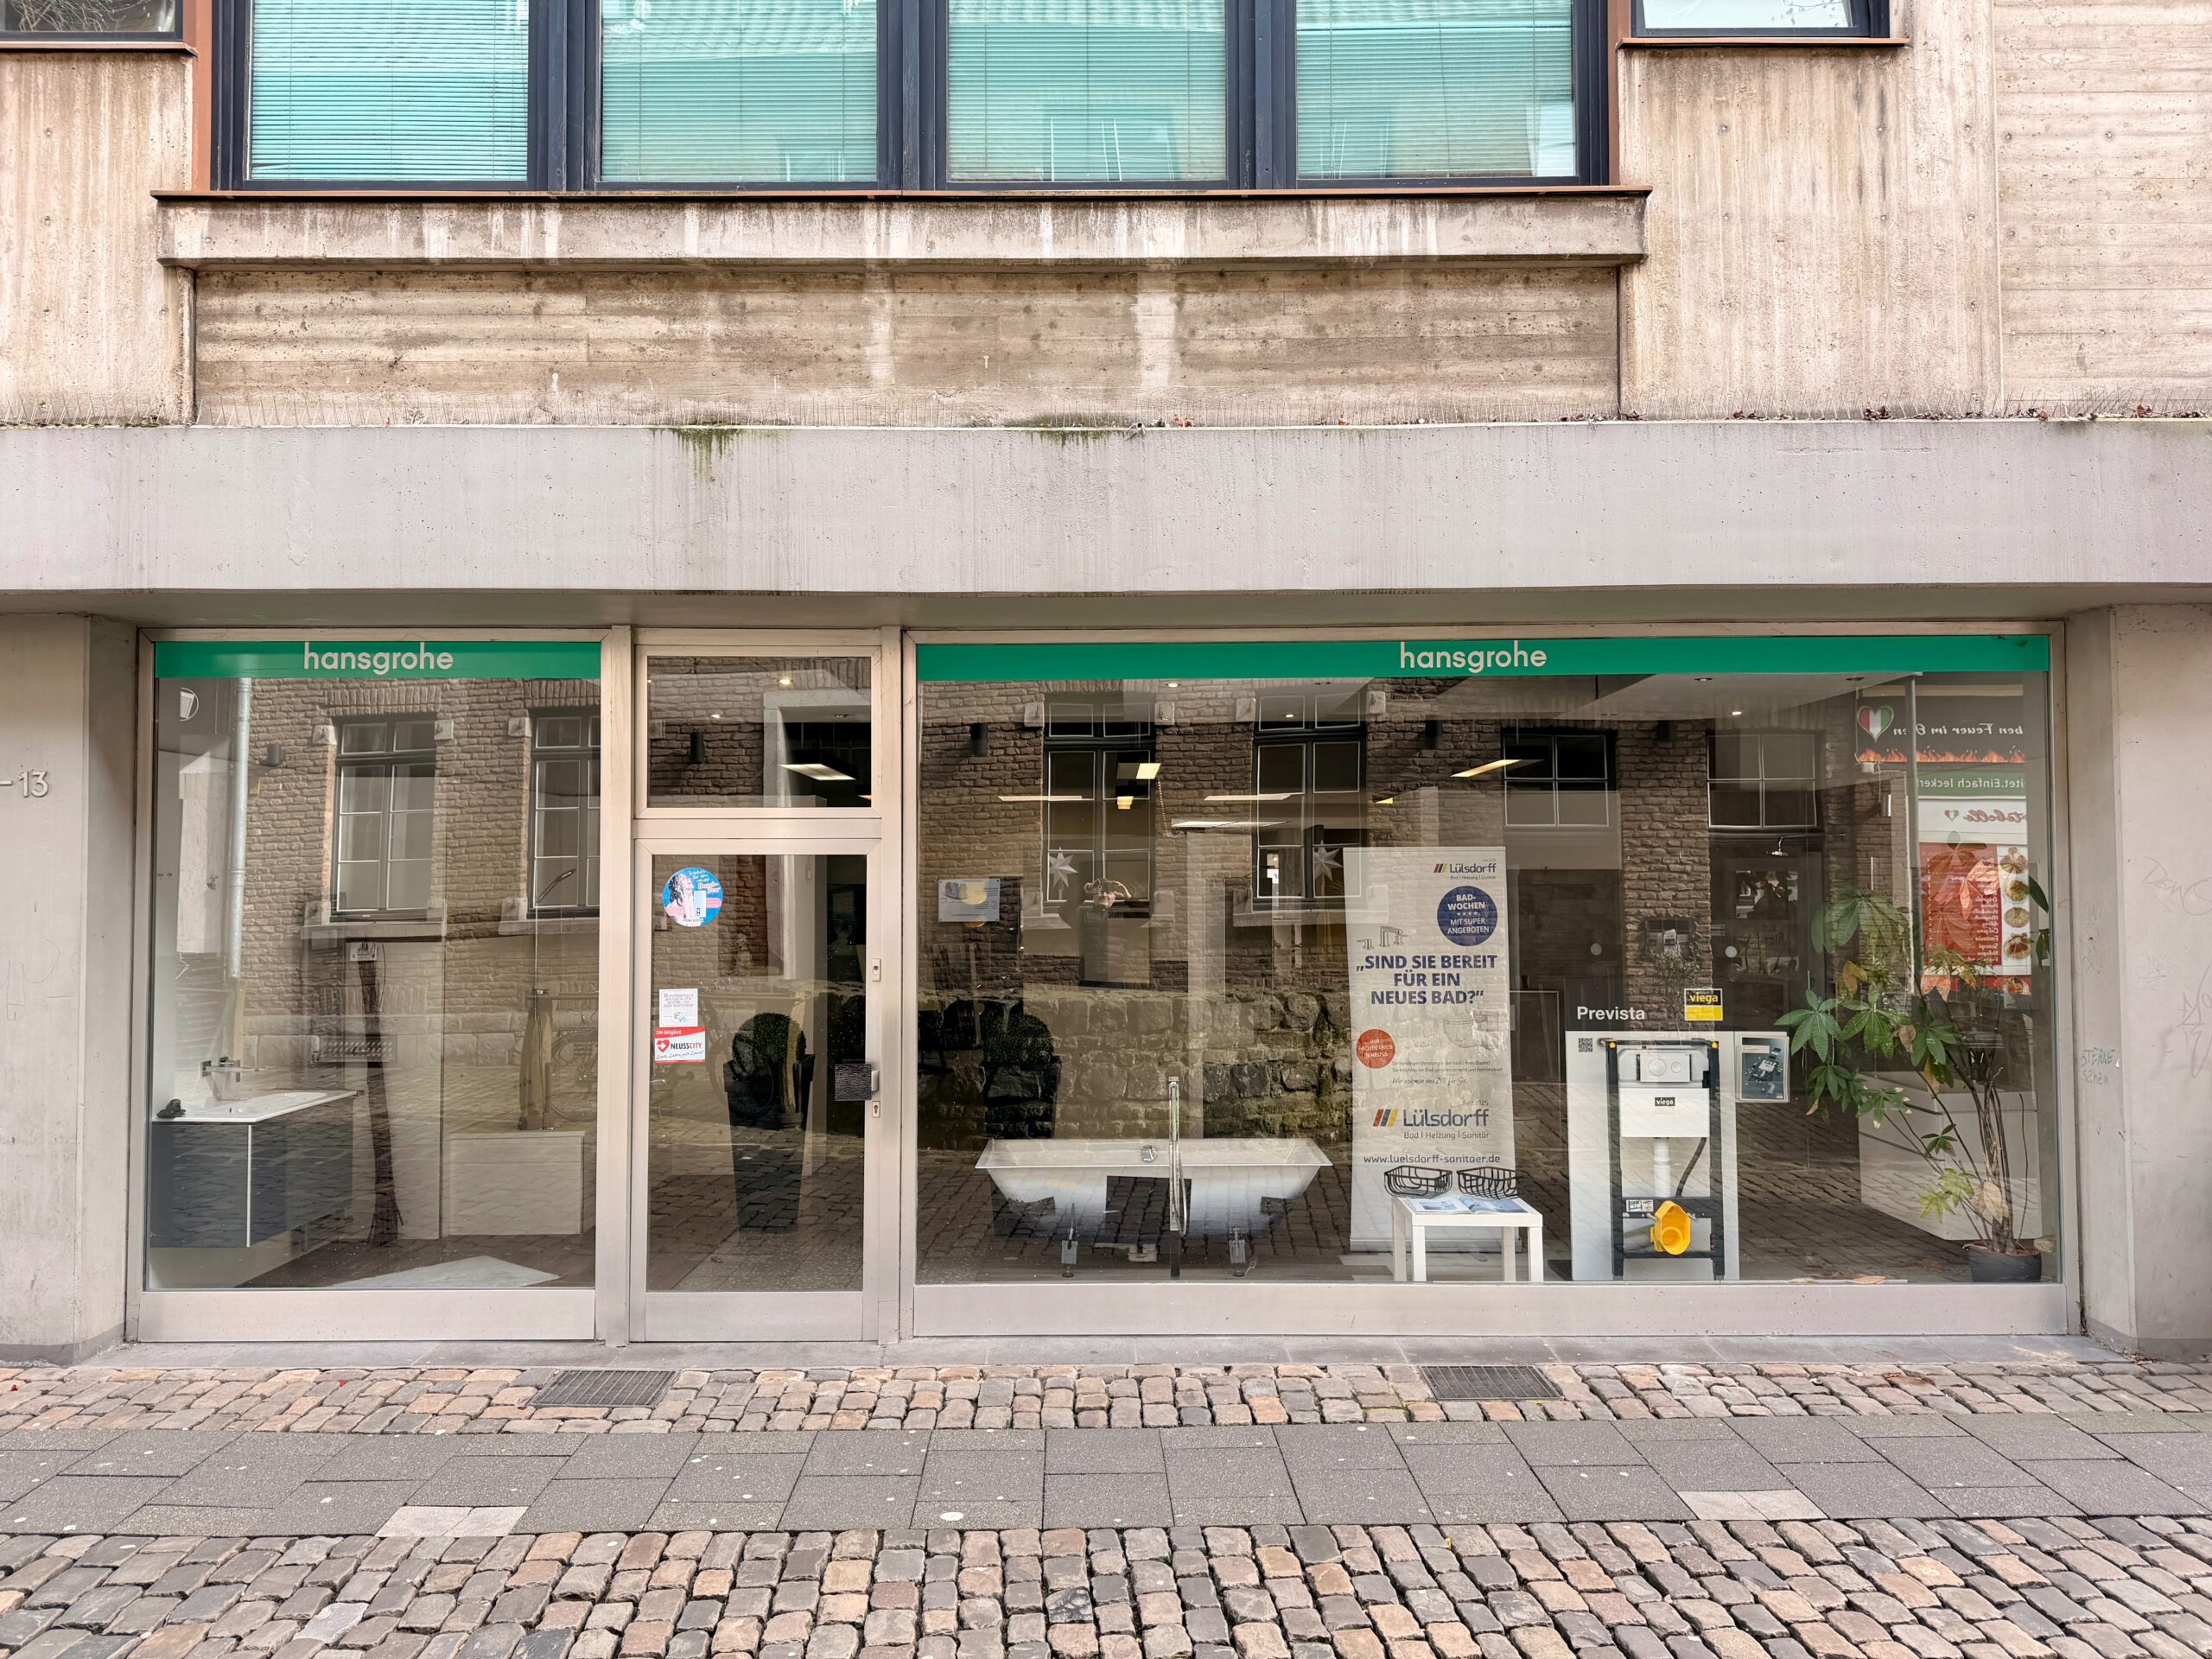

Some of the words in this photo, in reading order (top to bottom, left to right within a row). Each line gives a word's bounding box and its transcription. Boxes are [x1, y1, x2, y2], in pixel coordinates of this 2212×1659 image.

[304, 642, 454, 675] hansgrohe
[1400, 640, 1547, 673] hansgrohe
[1450, 862, 1497, 874] Lülsdorff
[1447, 901, 1485, 911] WOCHEN
[1447, 925, 1490, 934] ANGEBOTEN
[1411, 955, 1436, 969] SIE
[1440, 955, 1497, 969] BEREIT
[1394, 969, 1427, 987] FÜR
[1432, 973, 1460, 987] EIN
[1370, 990, 1427, 1005] NEUES
[1689, 992, 1719, 1004] viega
[1577, 1006, 1646, 1020] Prevista
[1656, 1097, 1674, 1106] viega
[1403, 1109, 1489, 1127] Lülsdorff
[1425, 1131, 1456, 1140] Heizung
[1363, 1154, 1501, 1163] www.luelsdorff-sanitaer.de
